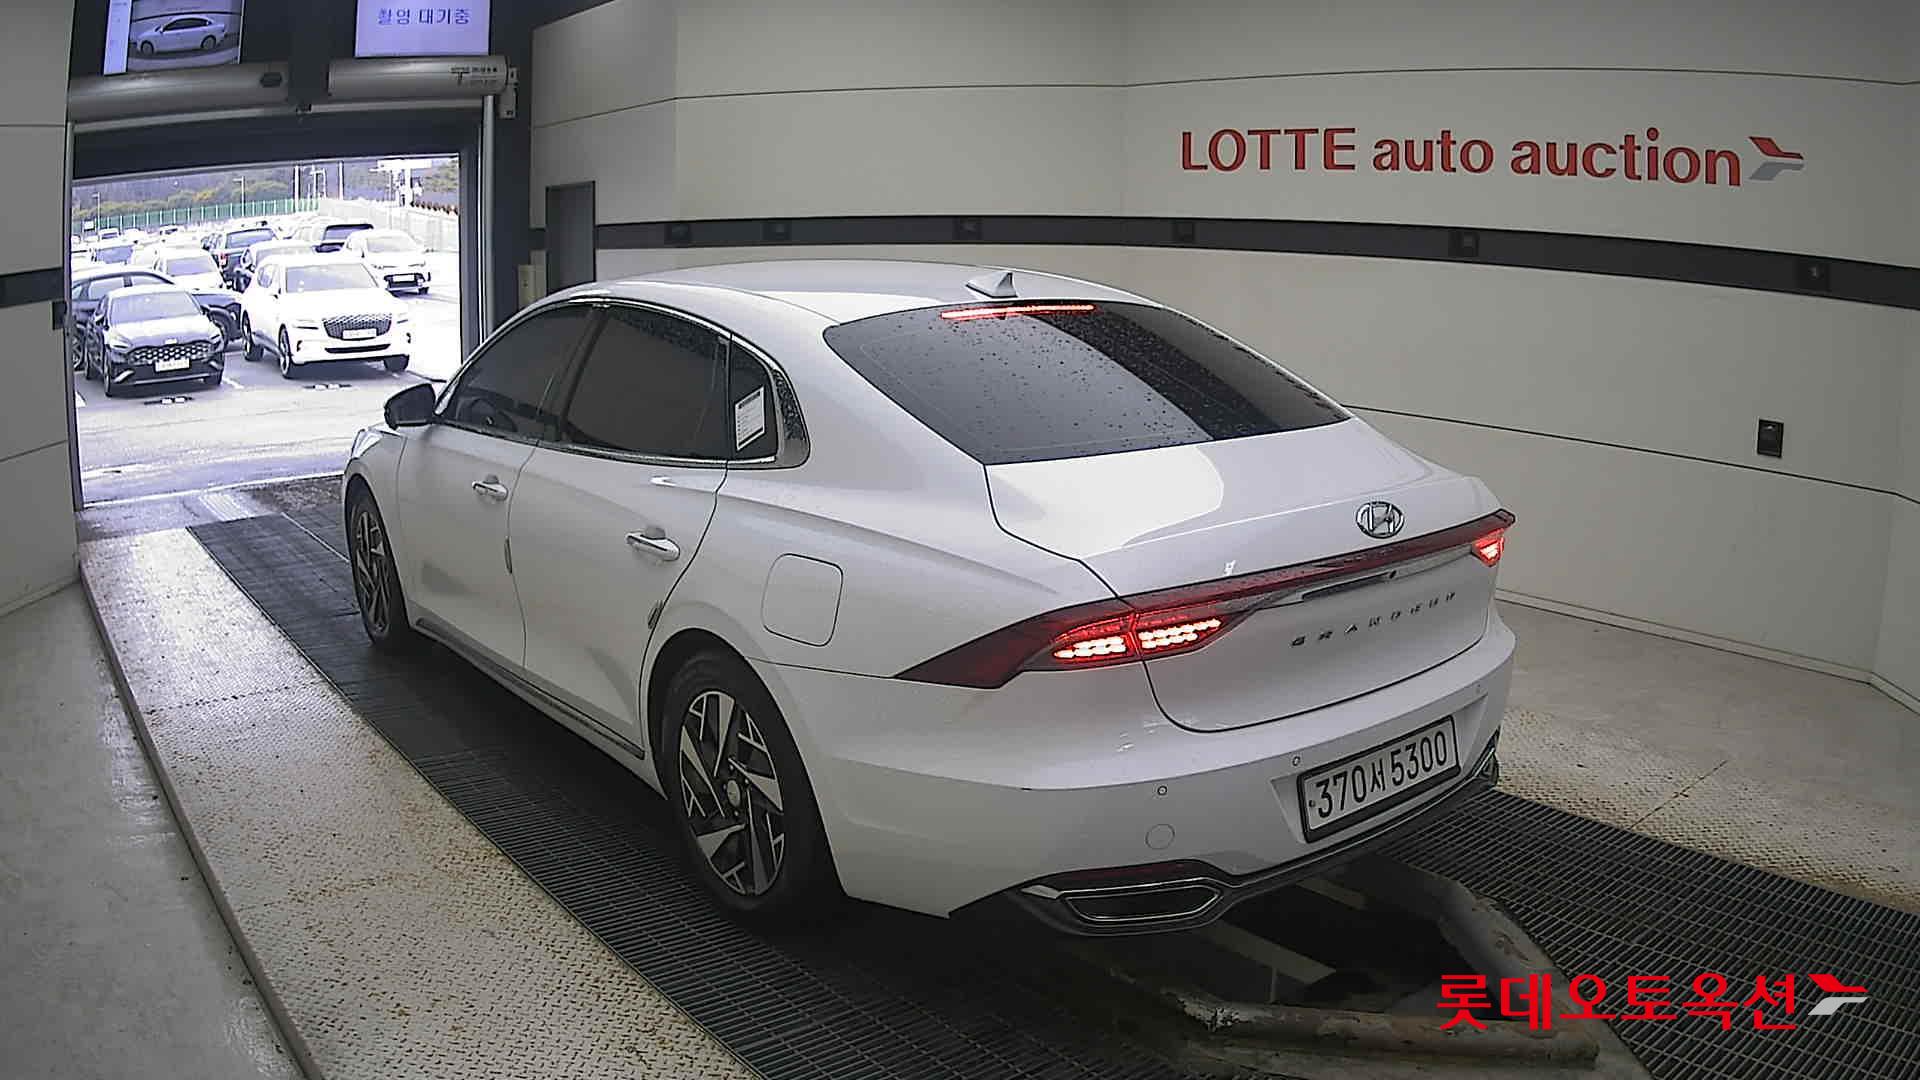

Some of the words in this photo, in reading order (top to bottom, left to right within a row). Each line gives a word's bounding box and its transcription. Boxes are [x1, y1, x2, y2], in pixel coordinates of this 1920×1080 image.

[418, 7, 470, 25] 대기중
[1181, 127, 1357, 172] LOTTE
[1371, 129, 1494, 174] auto
[1510, 127, 1742, 187] auction
